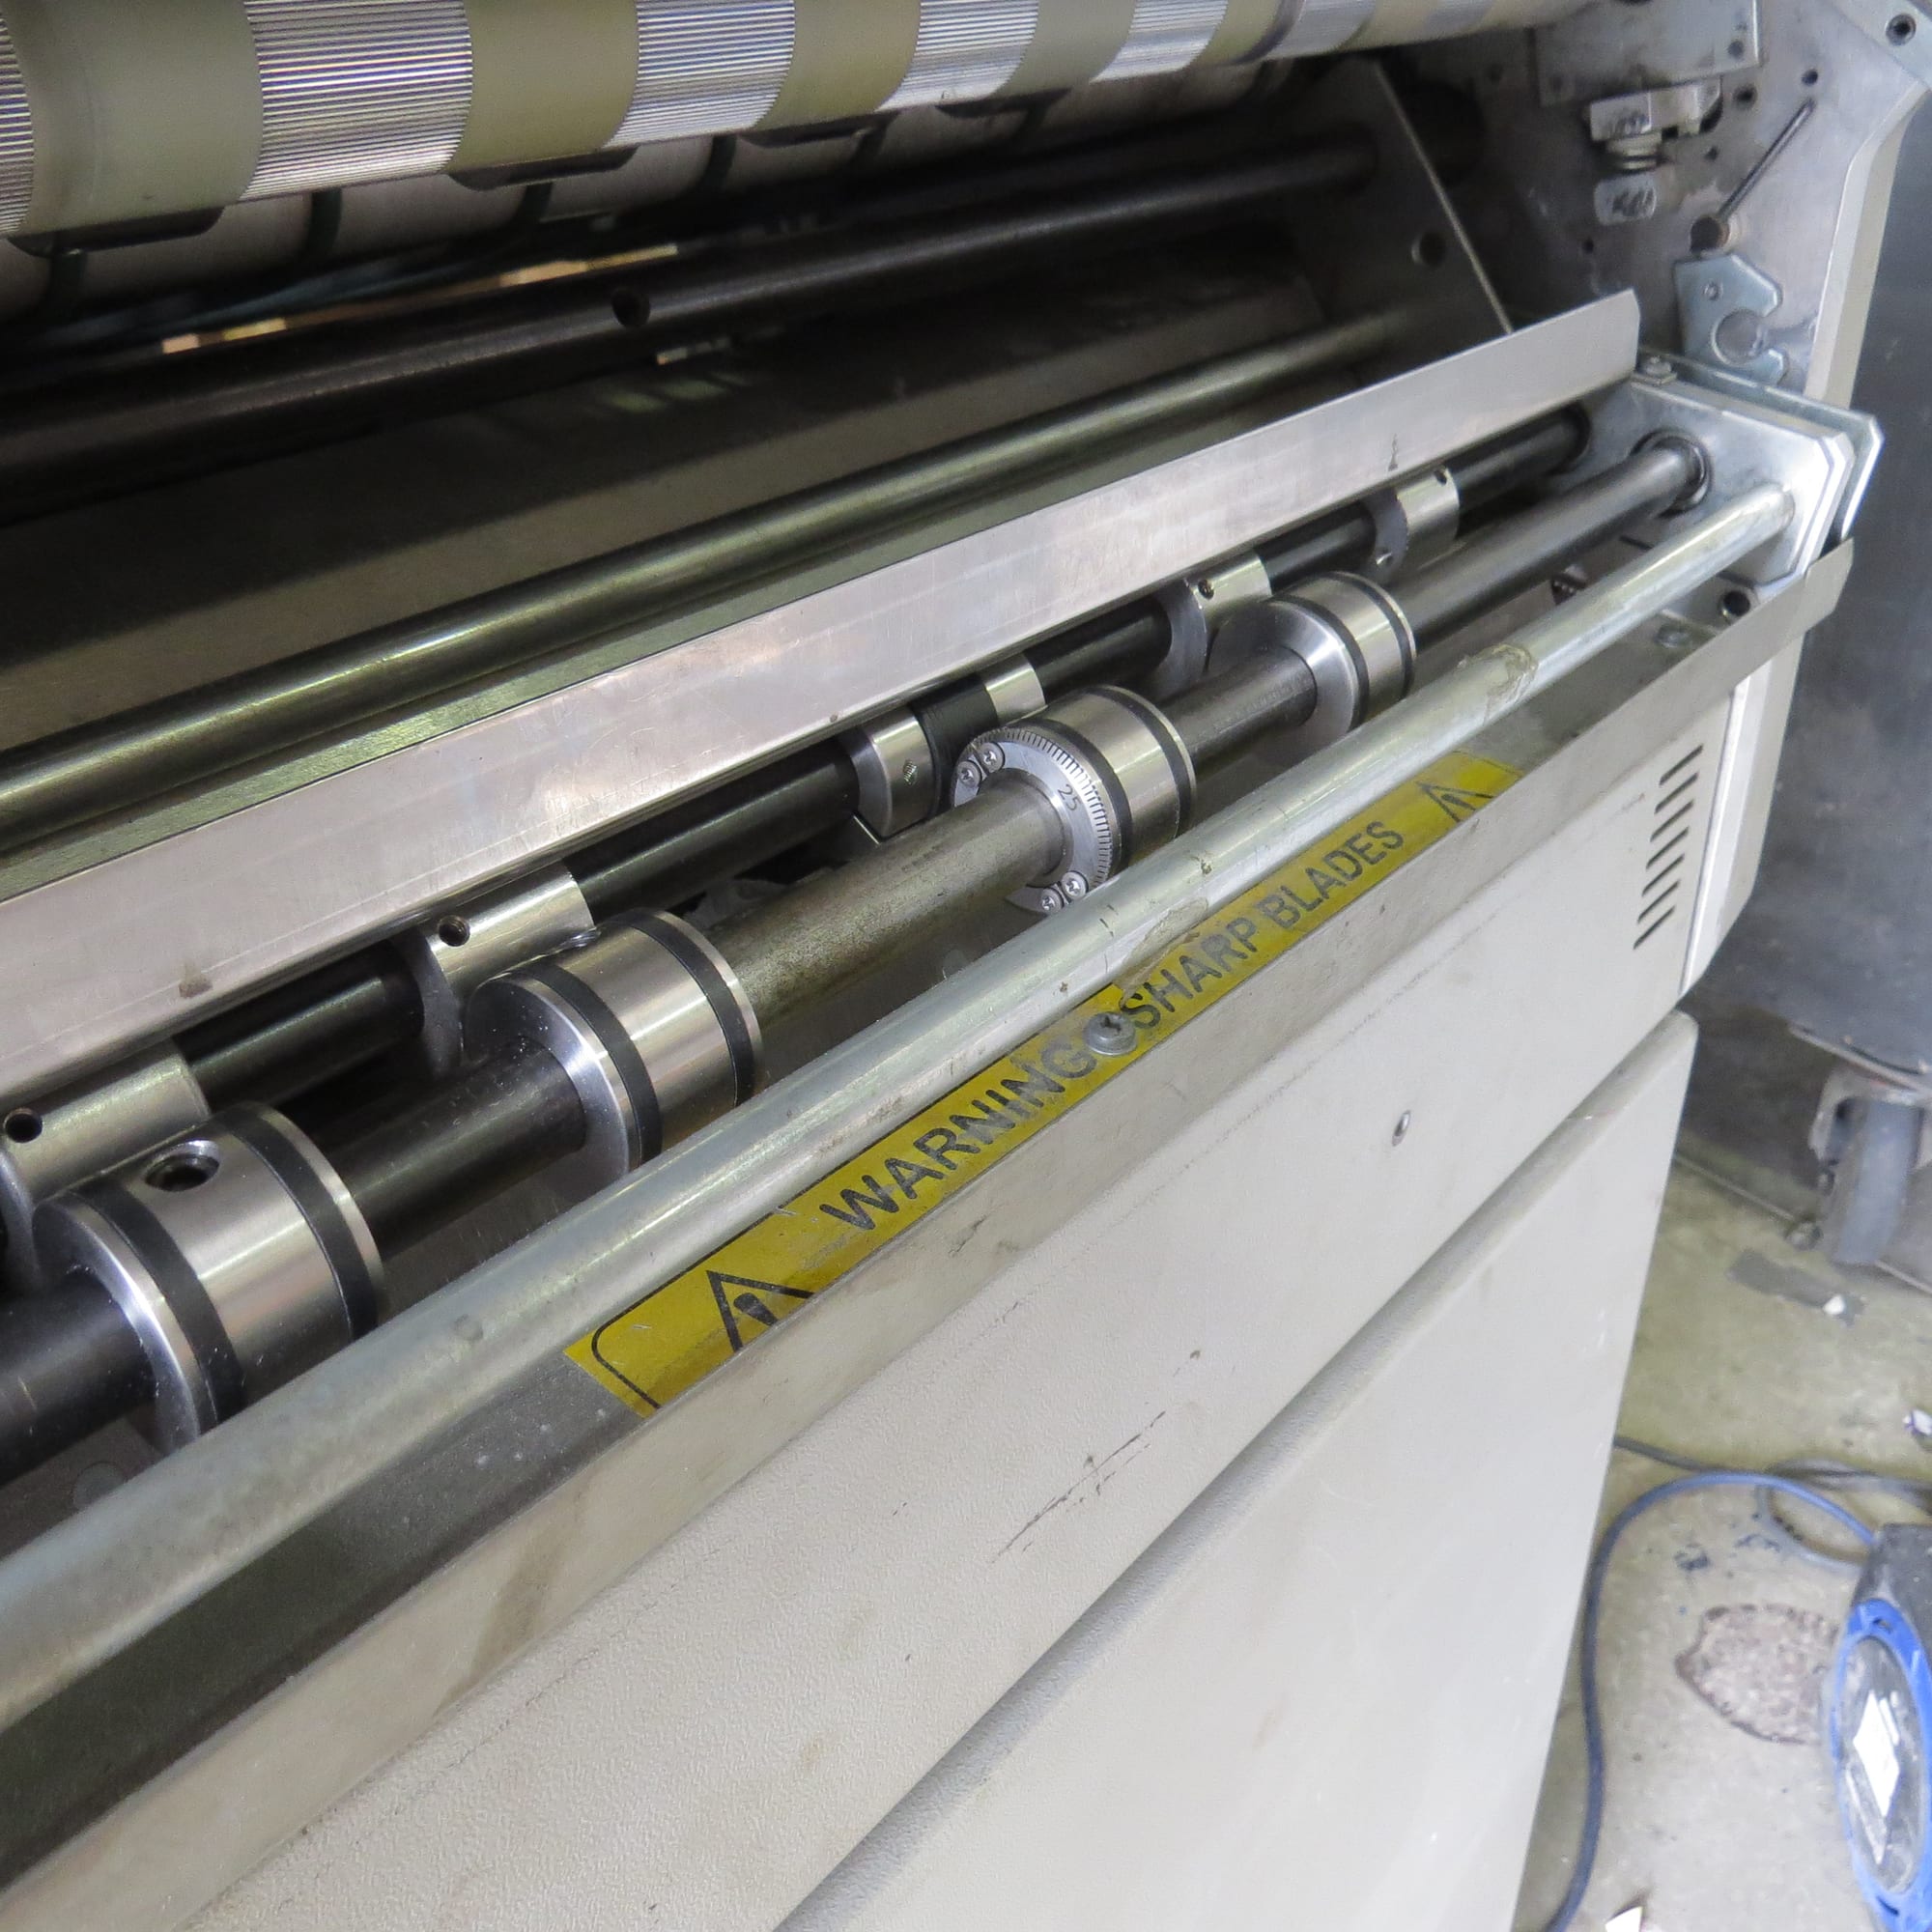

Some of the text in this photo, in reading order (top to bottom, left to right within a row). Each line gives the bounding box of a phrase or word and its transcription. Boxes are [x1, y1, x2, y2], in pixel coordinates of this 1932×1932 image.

[1057, 783, 1079, 811] 25
[818, 820, 1405, 1230] WARNING SHARP BLADES
